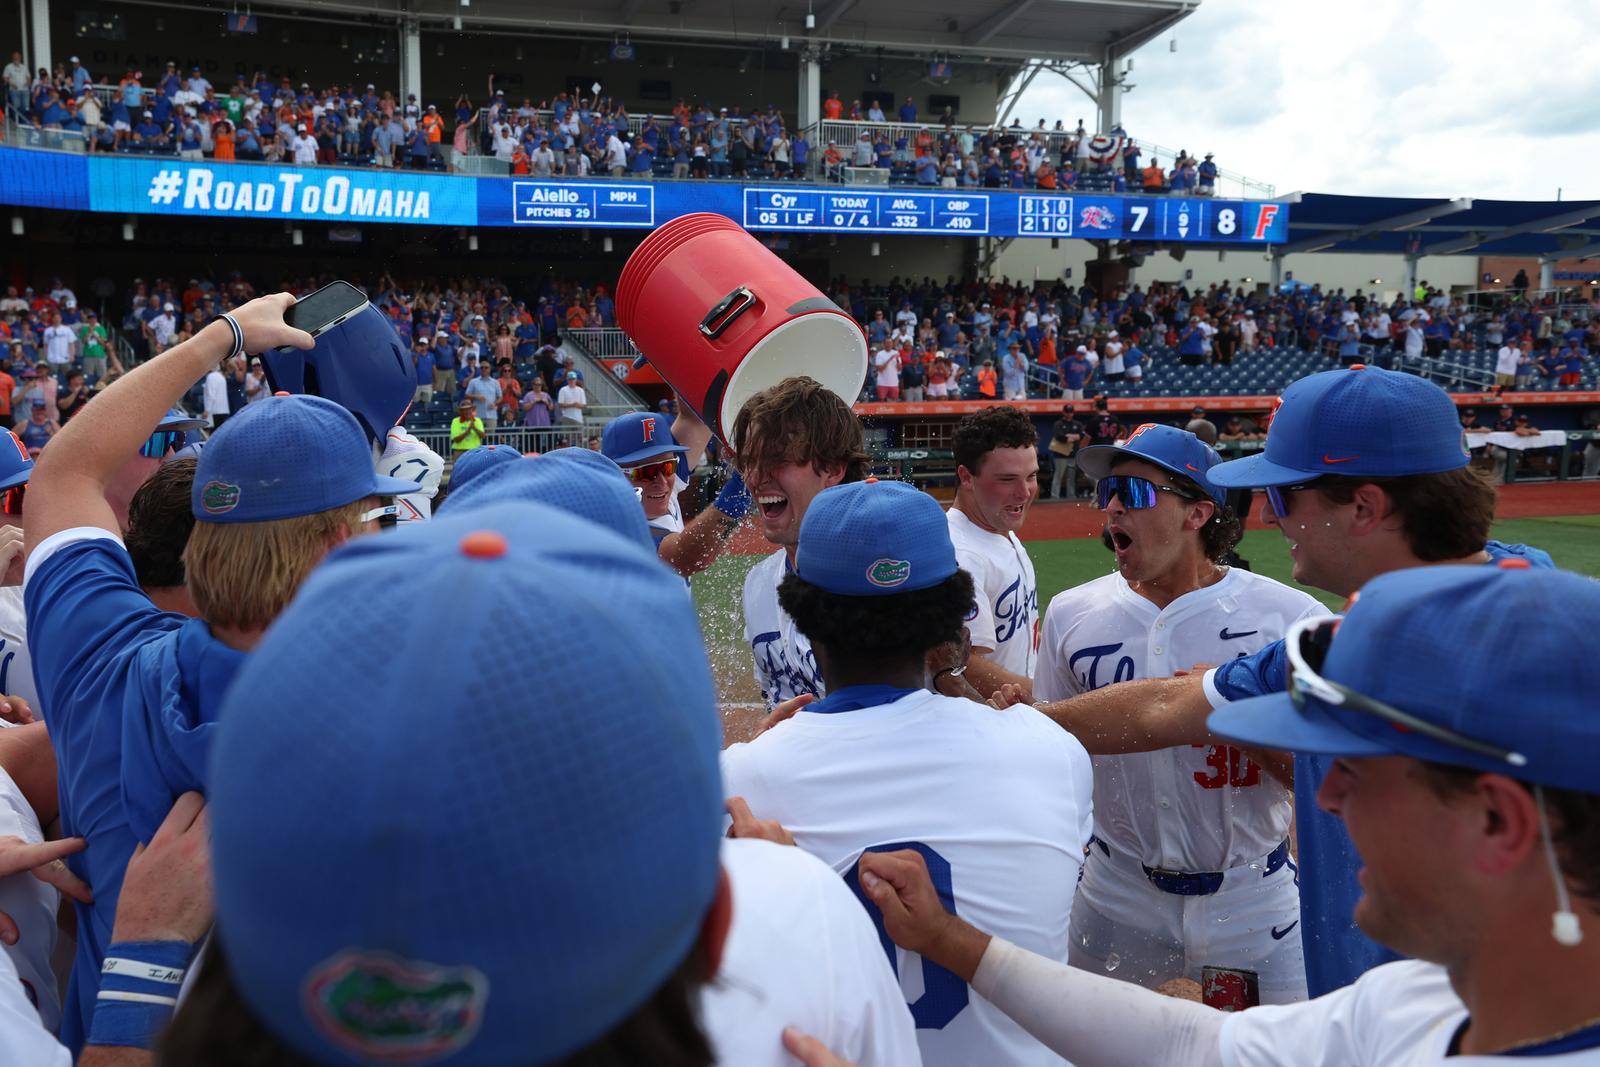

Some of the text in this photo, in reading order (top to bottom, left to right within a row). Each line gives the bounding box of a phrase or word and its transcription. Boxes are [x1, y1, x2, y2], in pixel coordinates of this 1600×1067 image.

[148, 168, 430, 218] #ROADTOOMAHA
[531, 188, 579, 203] Aiello
[609, 191, 637, 202] MPH
[771, 193, 797, 209] Cyr
[831, 198, 869, 209] TODAY
[891, 199, 918, 210] AVG.
[947, 201, 970, 211] OBP
[1025, 199, 1033, 213] B
[1042, 199, 1050, 214] S
[526, 207, 590, 218] PITCHES 29
[759, 212, 778, 224] 05
[797, 213, 814, 224] LF
[1130, 206, 1148, 232] 7
[891, 216, 918, 227] .332
[945, 217, 972, 228] .410
[1023, 217, 1068, 231] 2 1 0
[1178, 213, 1188, 227] 9
[1217, 209, 1236, 234] 8
[1252, 204, 1279, 240] F
[641, 418, 656, 443] F
